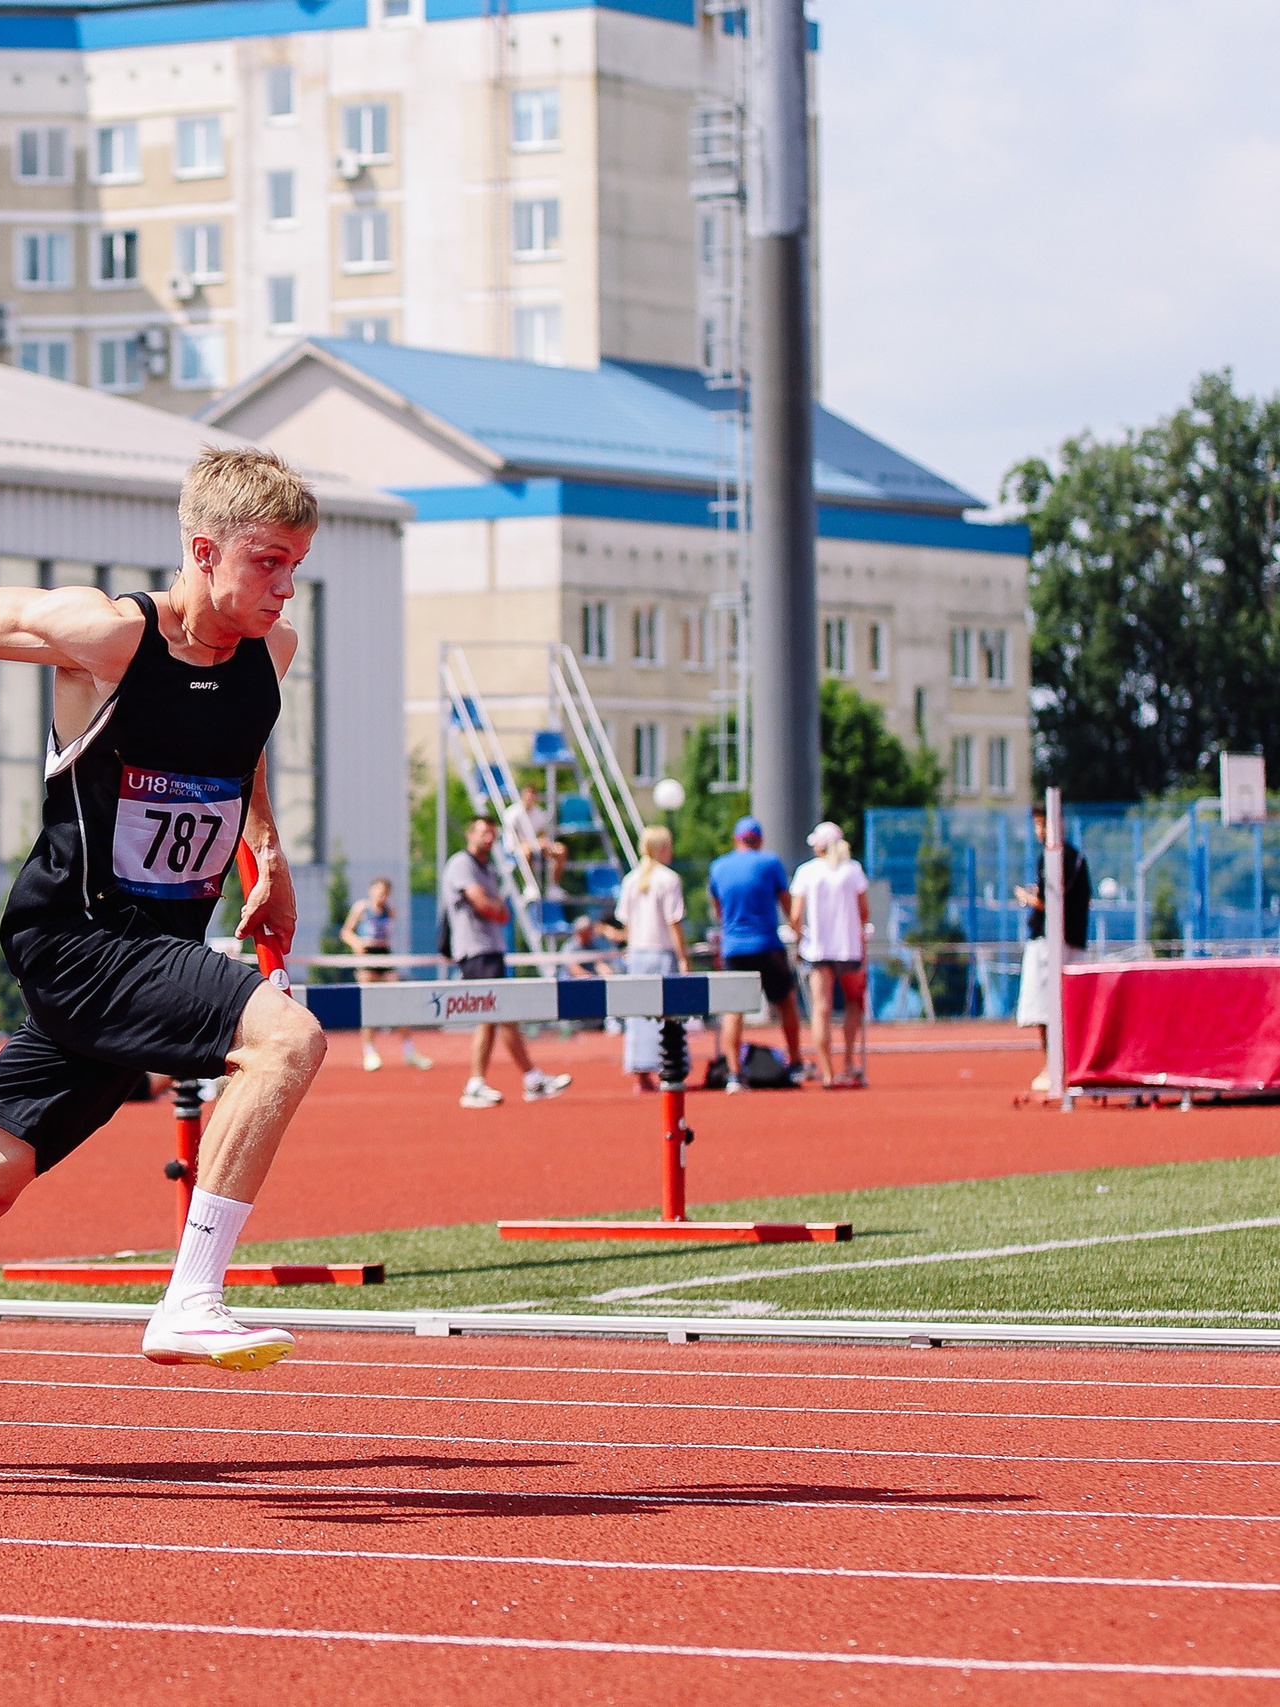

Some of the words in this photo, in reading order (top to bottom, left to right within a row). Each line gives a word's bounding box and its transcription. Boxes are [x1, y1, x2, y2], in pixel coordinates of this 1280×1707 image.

[190, 681, 213, 690] CRAFT
[127, 772, 168, 794] U18
[169, 787, 202, 798] РОССИИ
[142, 808, 223, 873] 787
[445, 989, 497, 1019] polanik
